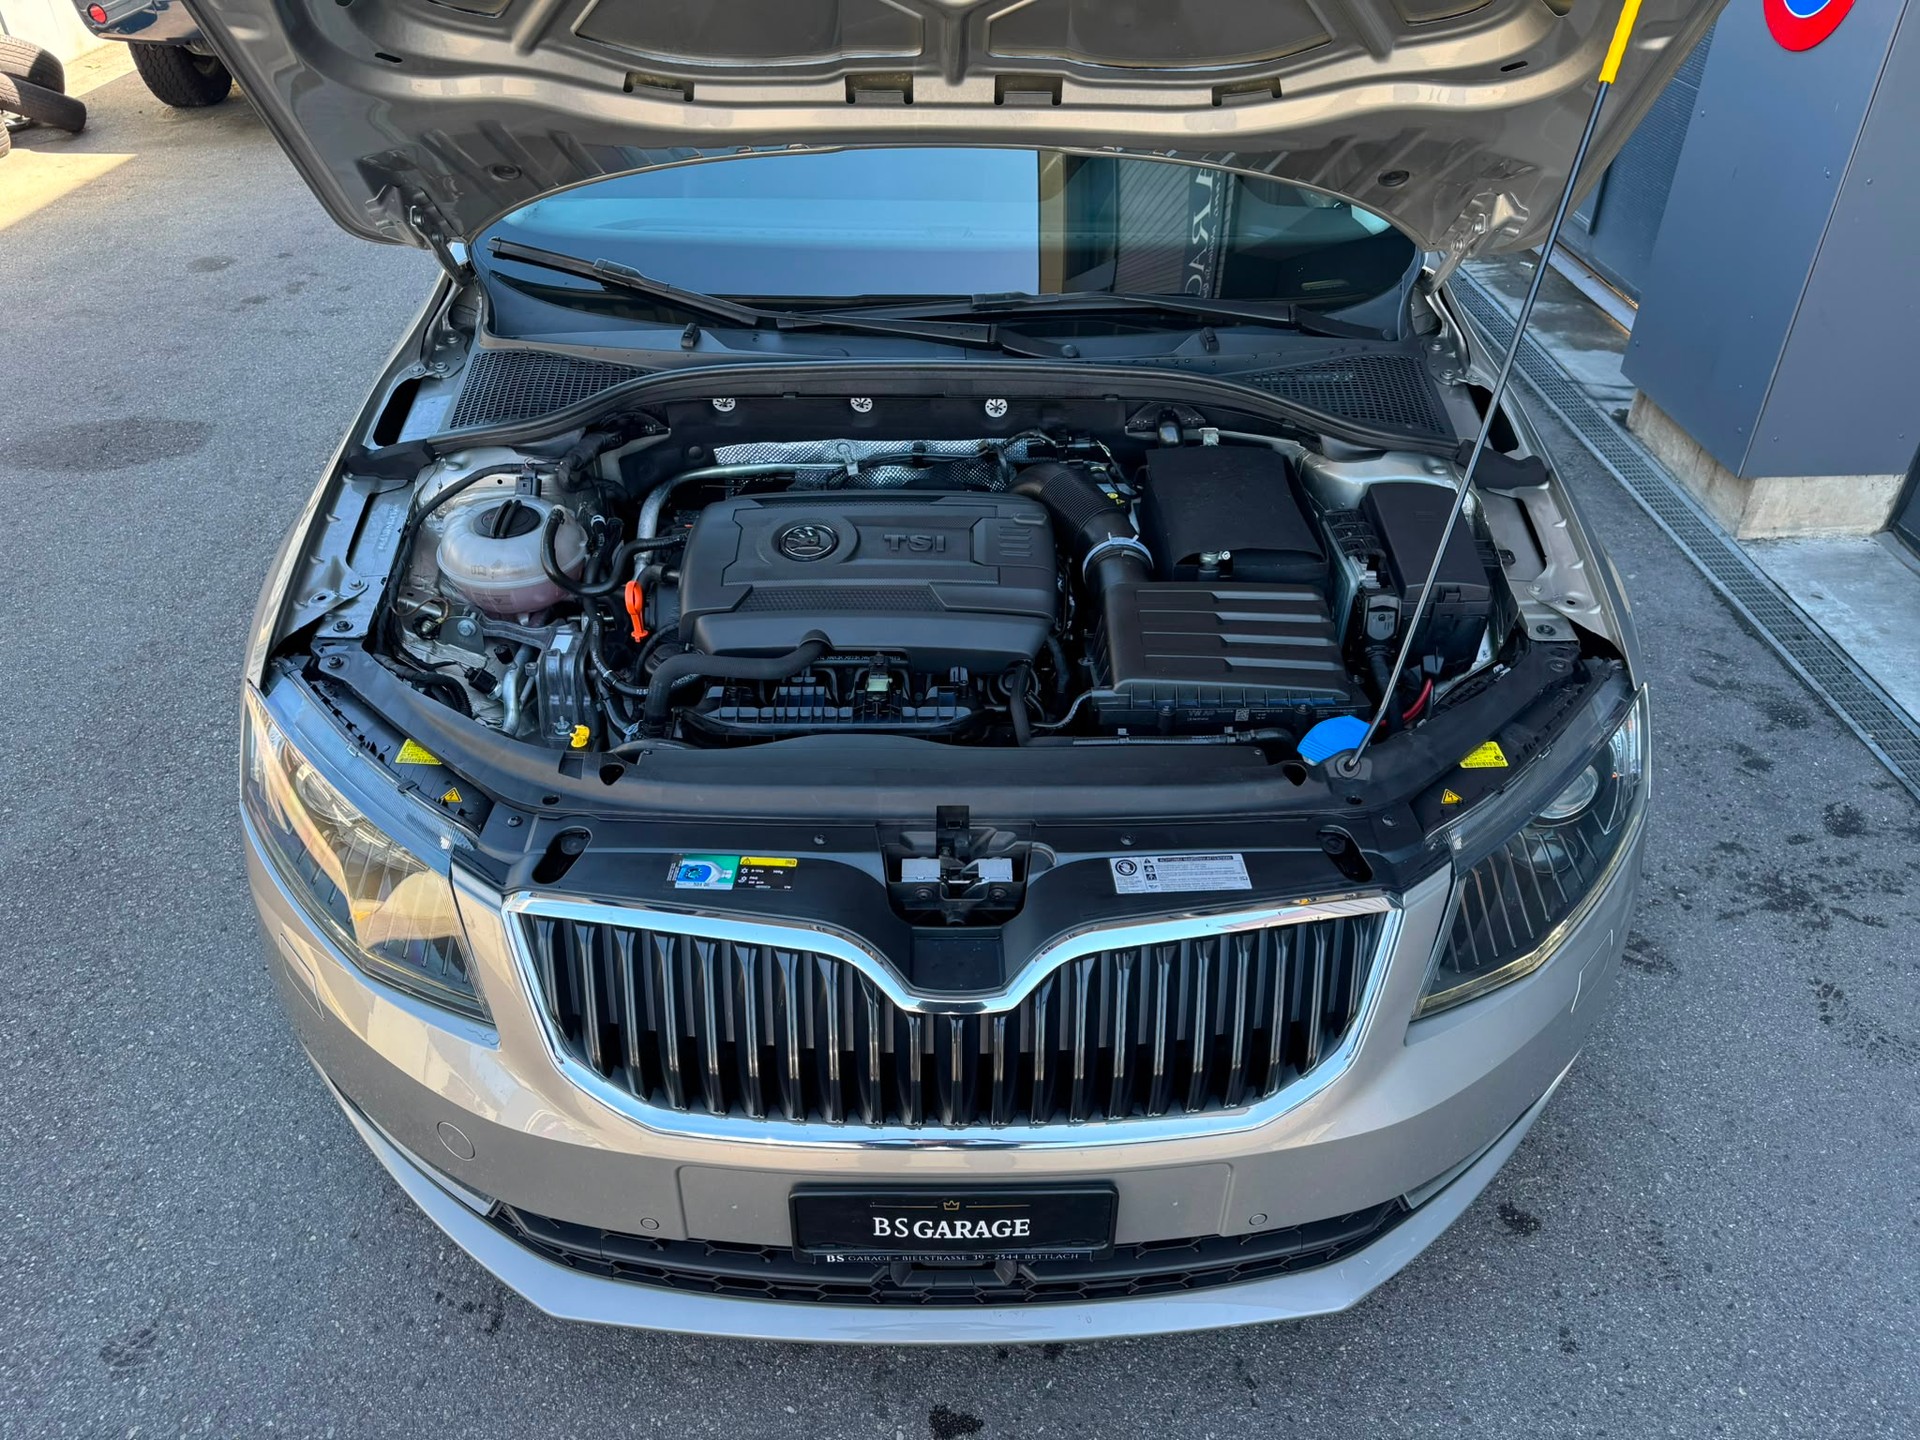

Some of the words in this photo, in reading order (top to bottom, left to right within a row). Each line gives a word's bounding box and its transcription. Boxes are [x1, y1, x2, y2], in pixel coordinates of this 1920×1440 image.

[883, 533, 947, 553] TSI
[872, 1217, 909, 1238] BS
[913, 1218, 1031, 1239] GARAGE
[826, 1254, 845, 1263] BS
[848, 1254, 891, 1262] GARAGE
[994, 1253, 1018, 1261] 2544
